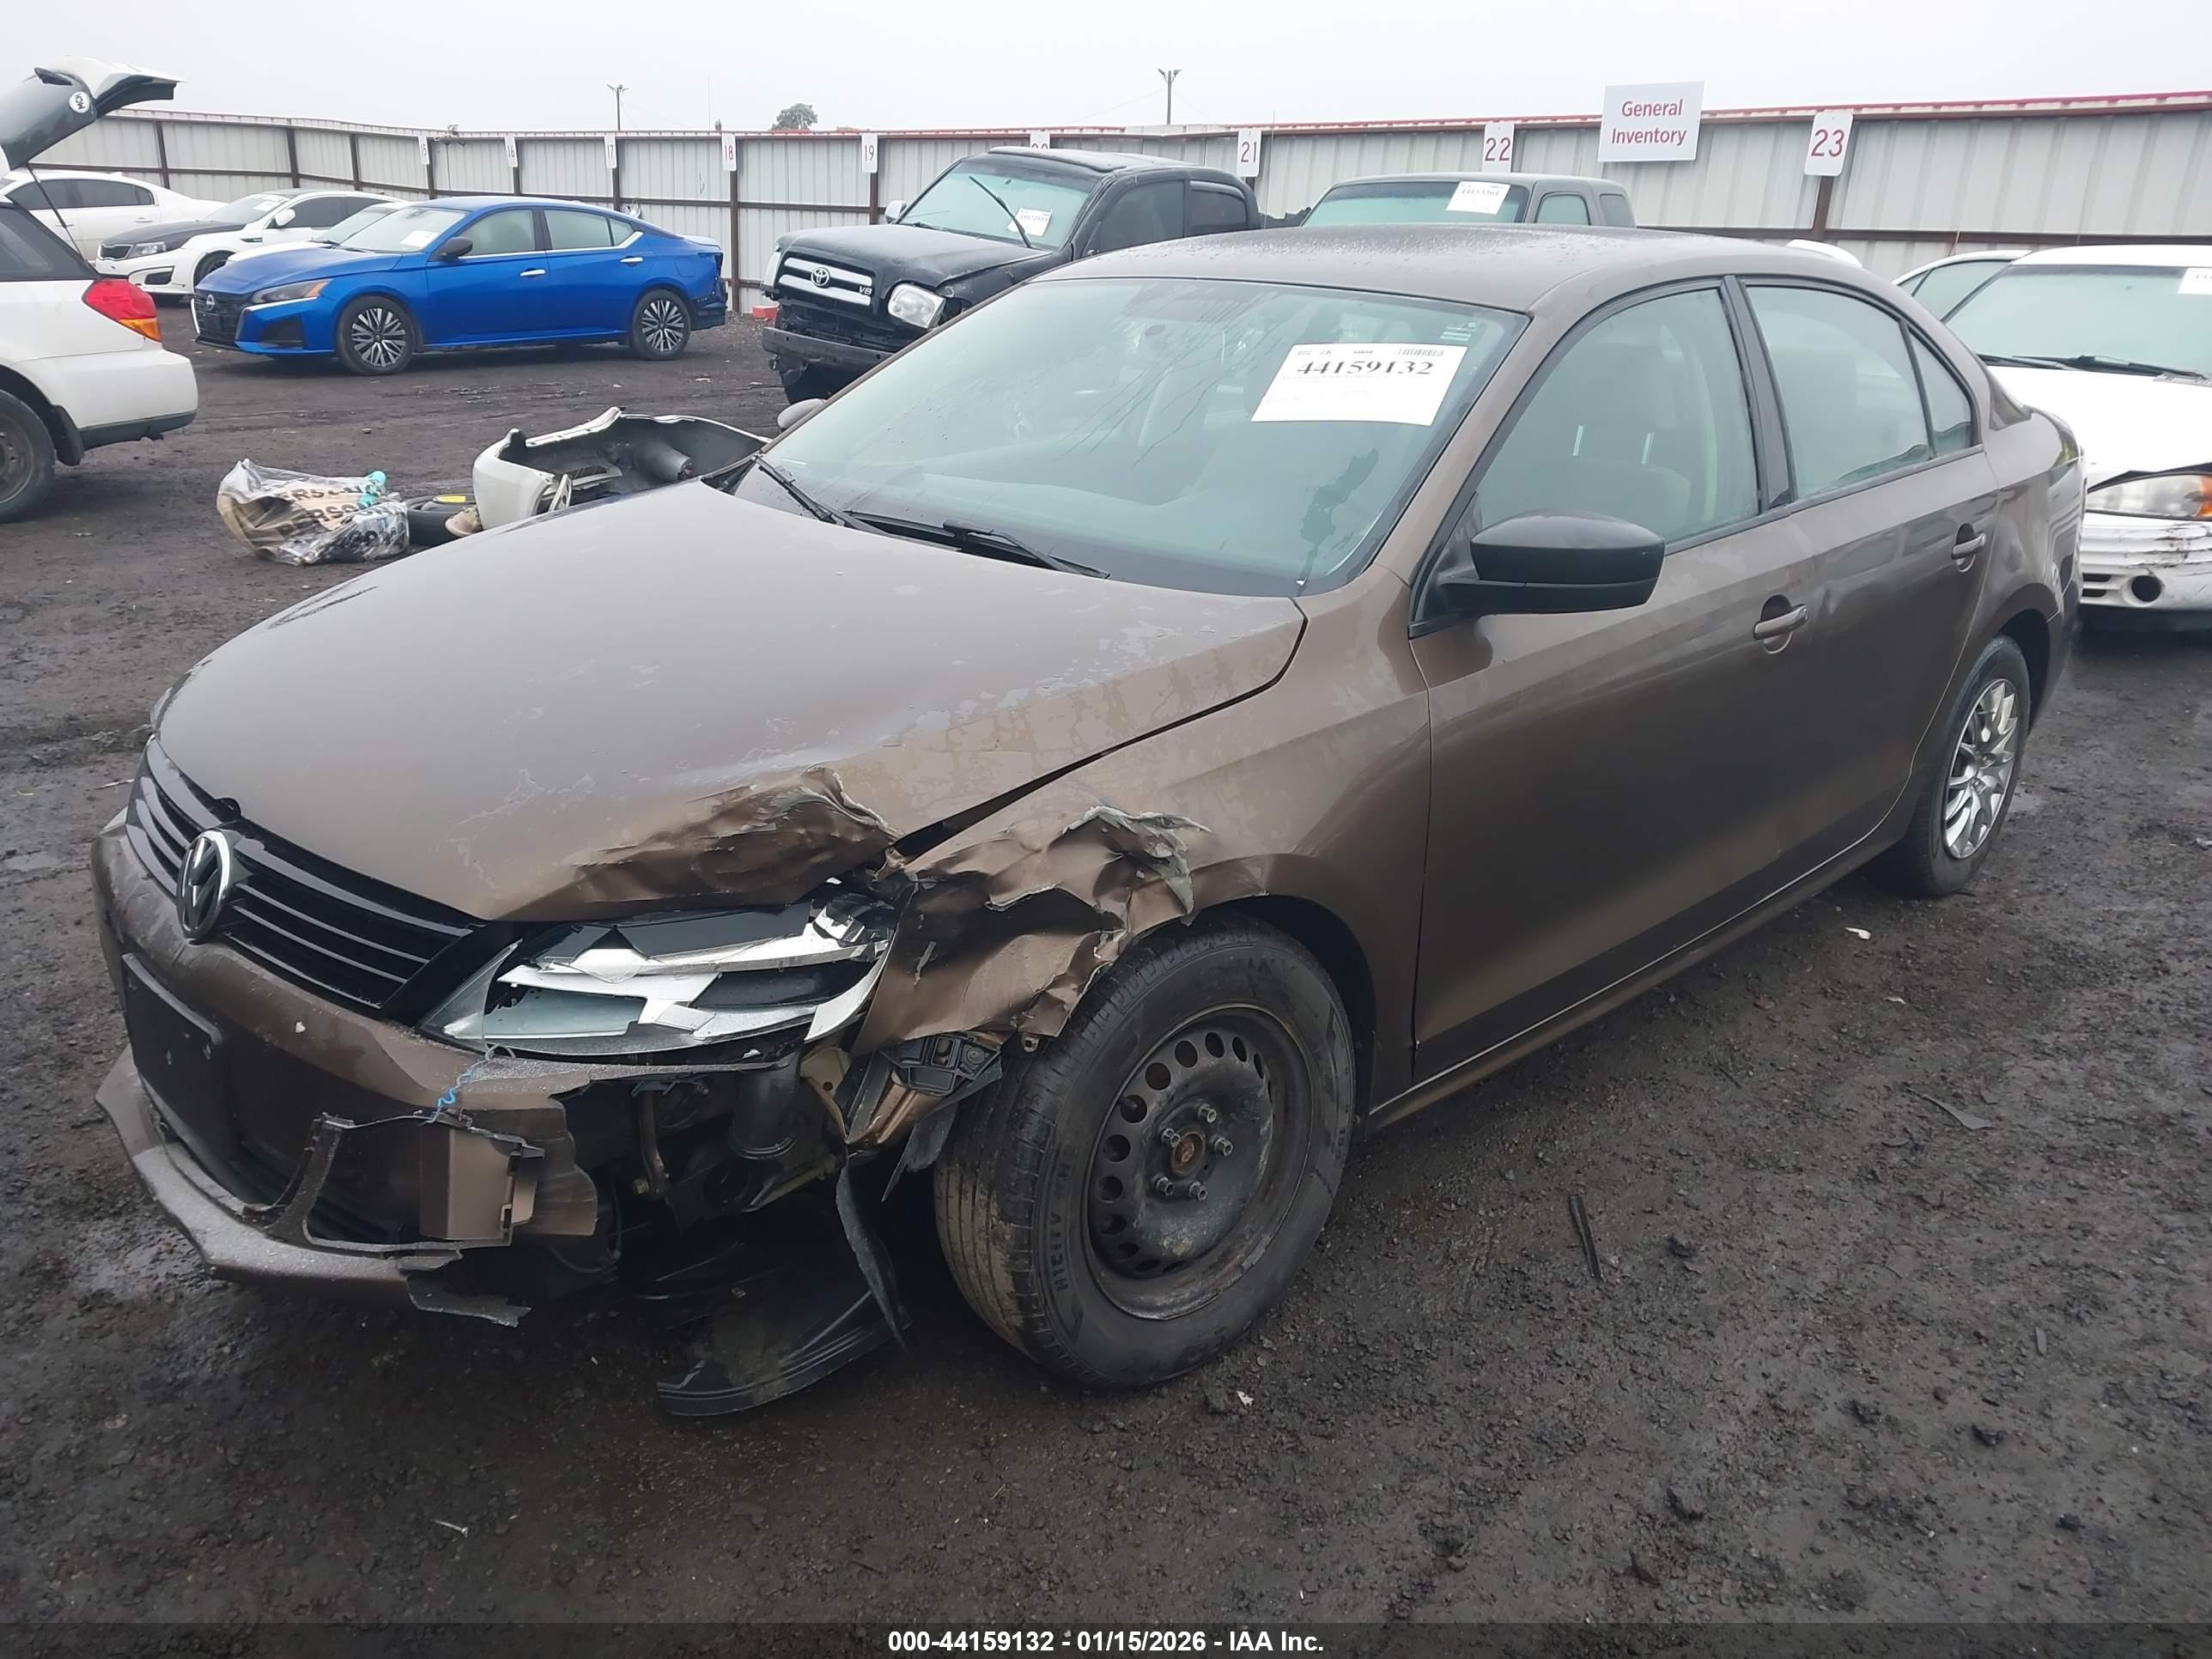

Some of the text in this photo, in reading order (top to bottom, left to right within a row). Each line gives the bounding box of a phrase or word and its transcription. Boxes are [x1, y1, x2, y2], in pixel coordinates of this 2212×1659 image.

[1621, 98, 1683, 118] General
[1612, 128, 1687, 146] Inventory
[1811, 129, 1844, 157] 23
[420, 143, 428, 157] 15
[507, 143, 515, 158] 16
[607, 143, 614, 159] 17
[724, 144, 733, 161] 18
[864, 144, 875, 162] 19
[1241, 141, 1257, 163] 21
[1485, 137, 1511, 161] 22
[859, 285, 872, 295] V8
[1297, 361, 1434, 374] 44159132
